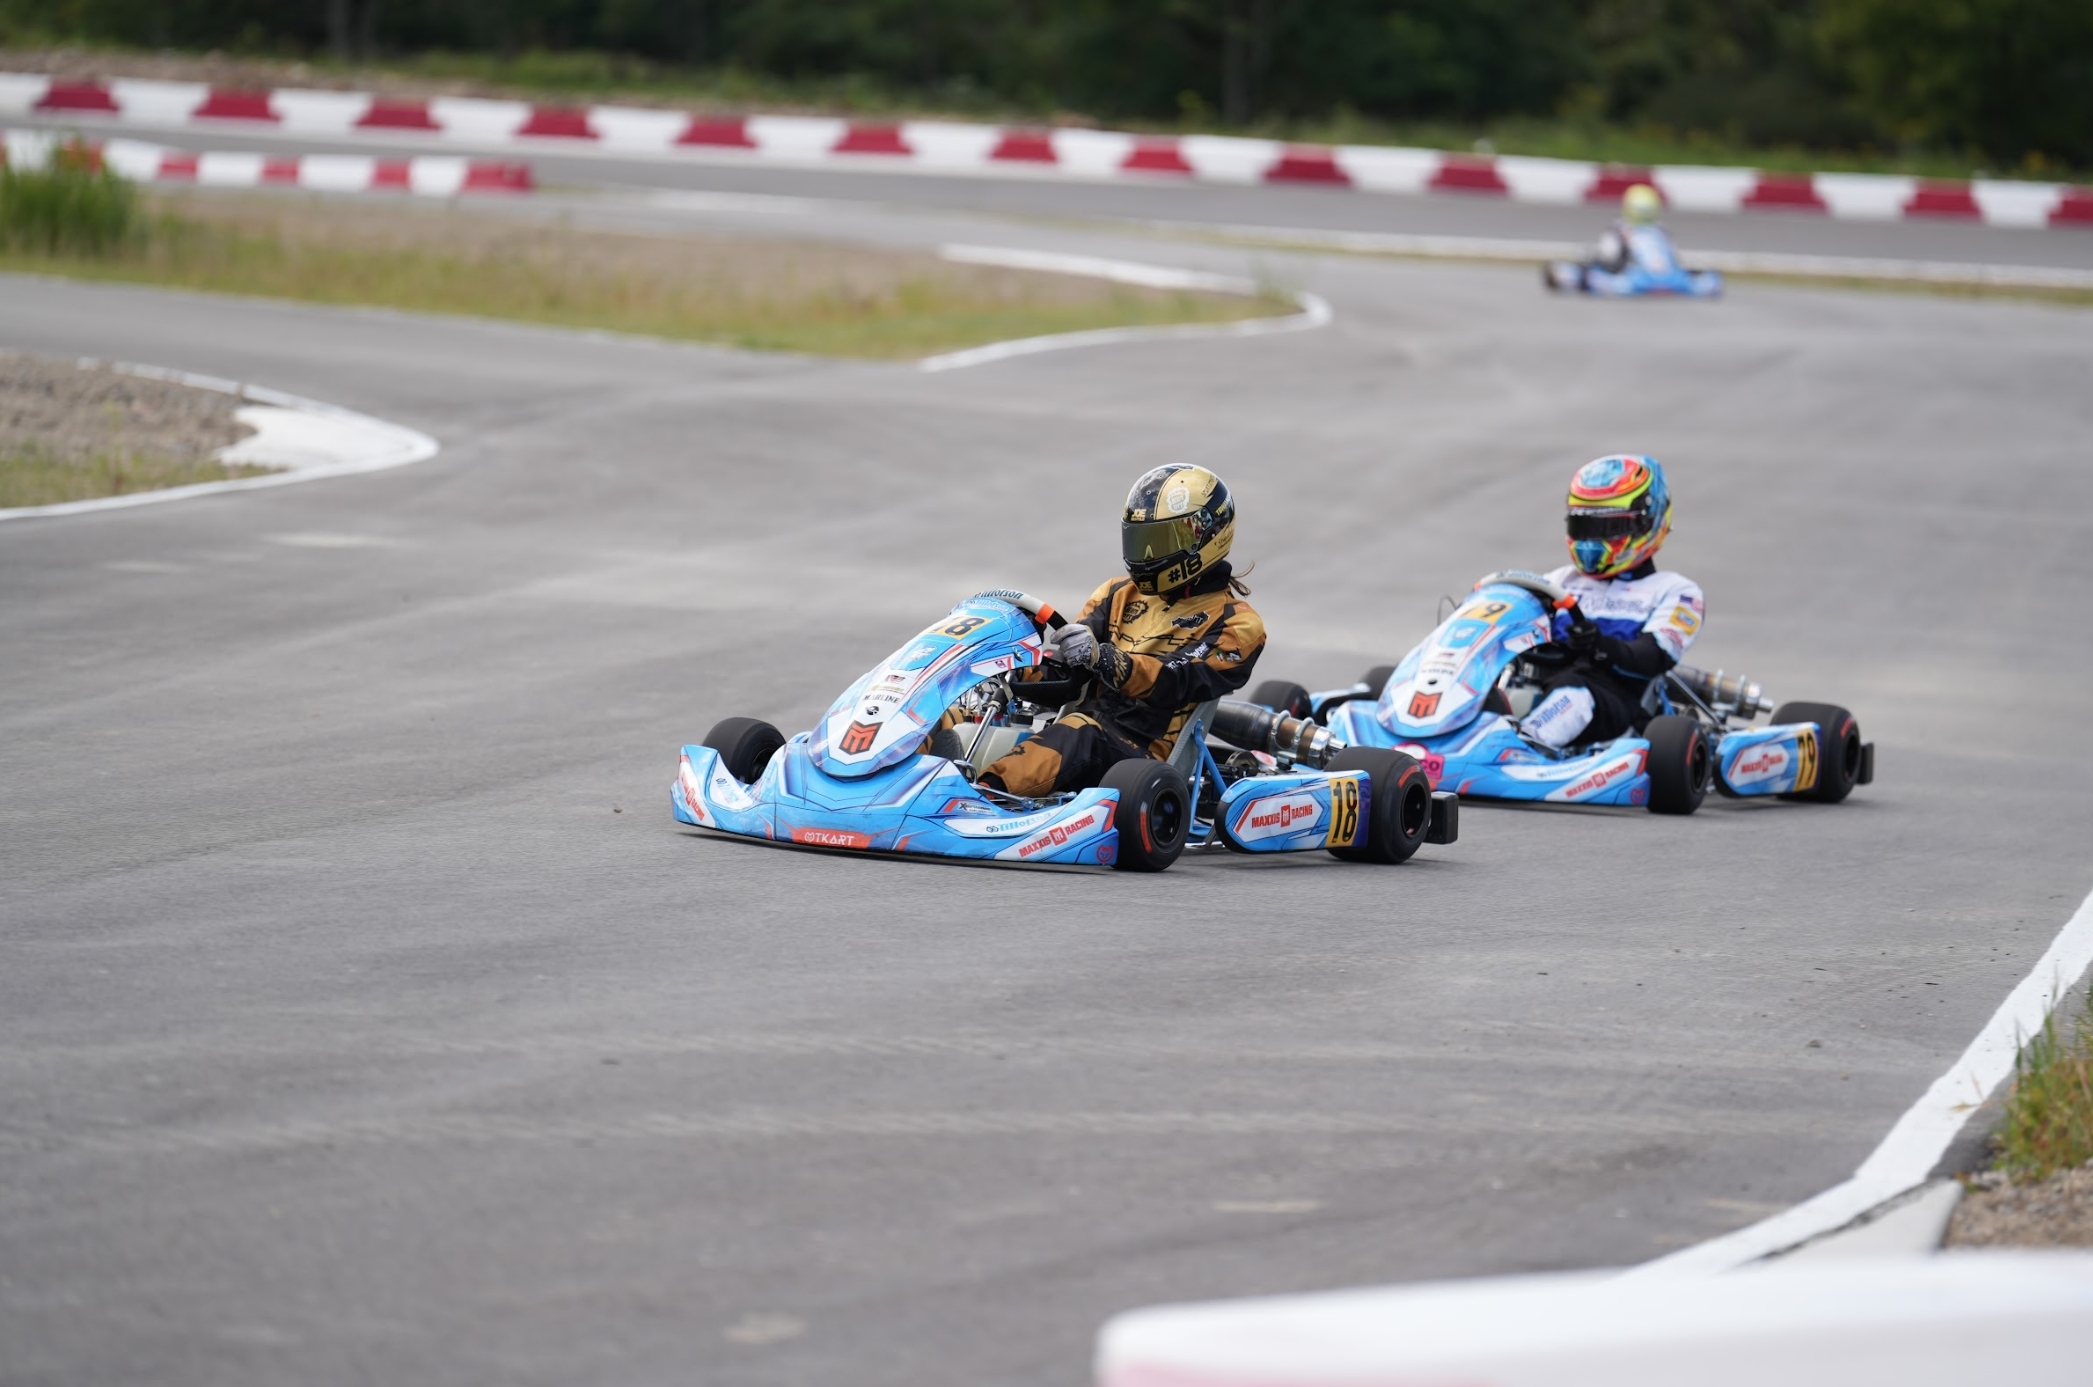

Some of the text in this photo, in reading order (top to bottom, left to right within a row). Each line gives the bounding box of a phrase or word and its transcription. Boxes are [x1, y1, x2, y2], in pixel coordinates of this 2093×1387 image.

[1168, 555, 1203, 584] #18
[1252, 812, 1280, 828] MAXXIS
[1291, 804, 1313, 820] RACING
[1331, 781, 1358, 843] 18
[1018, 836, 1052, 858] MAXXIS
[1066, 814, 1096, 836] RACING
